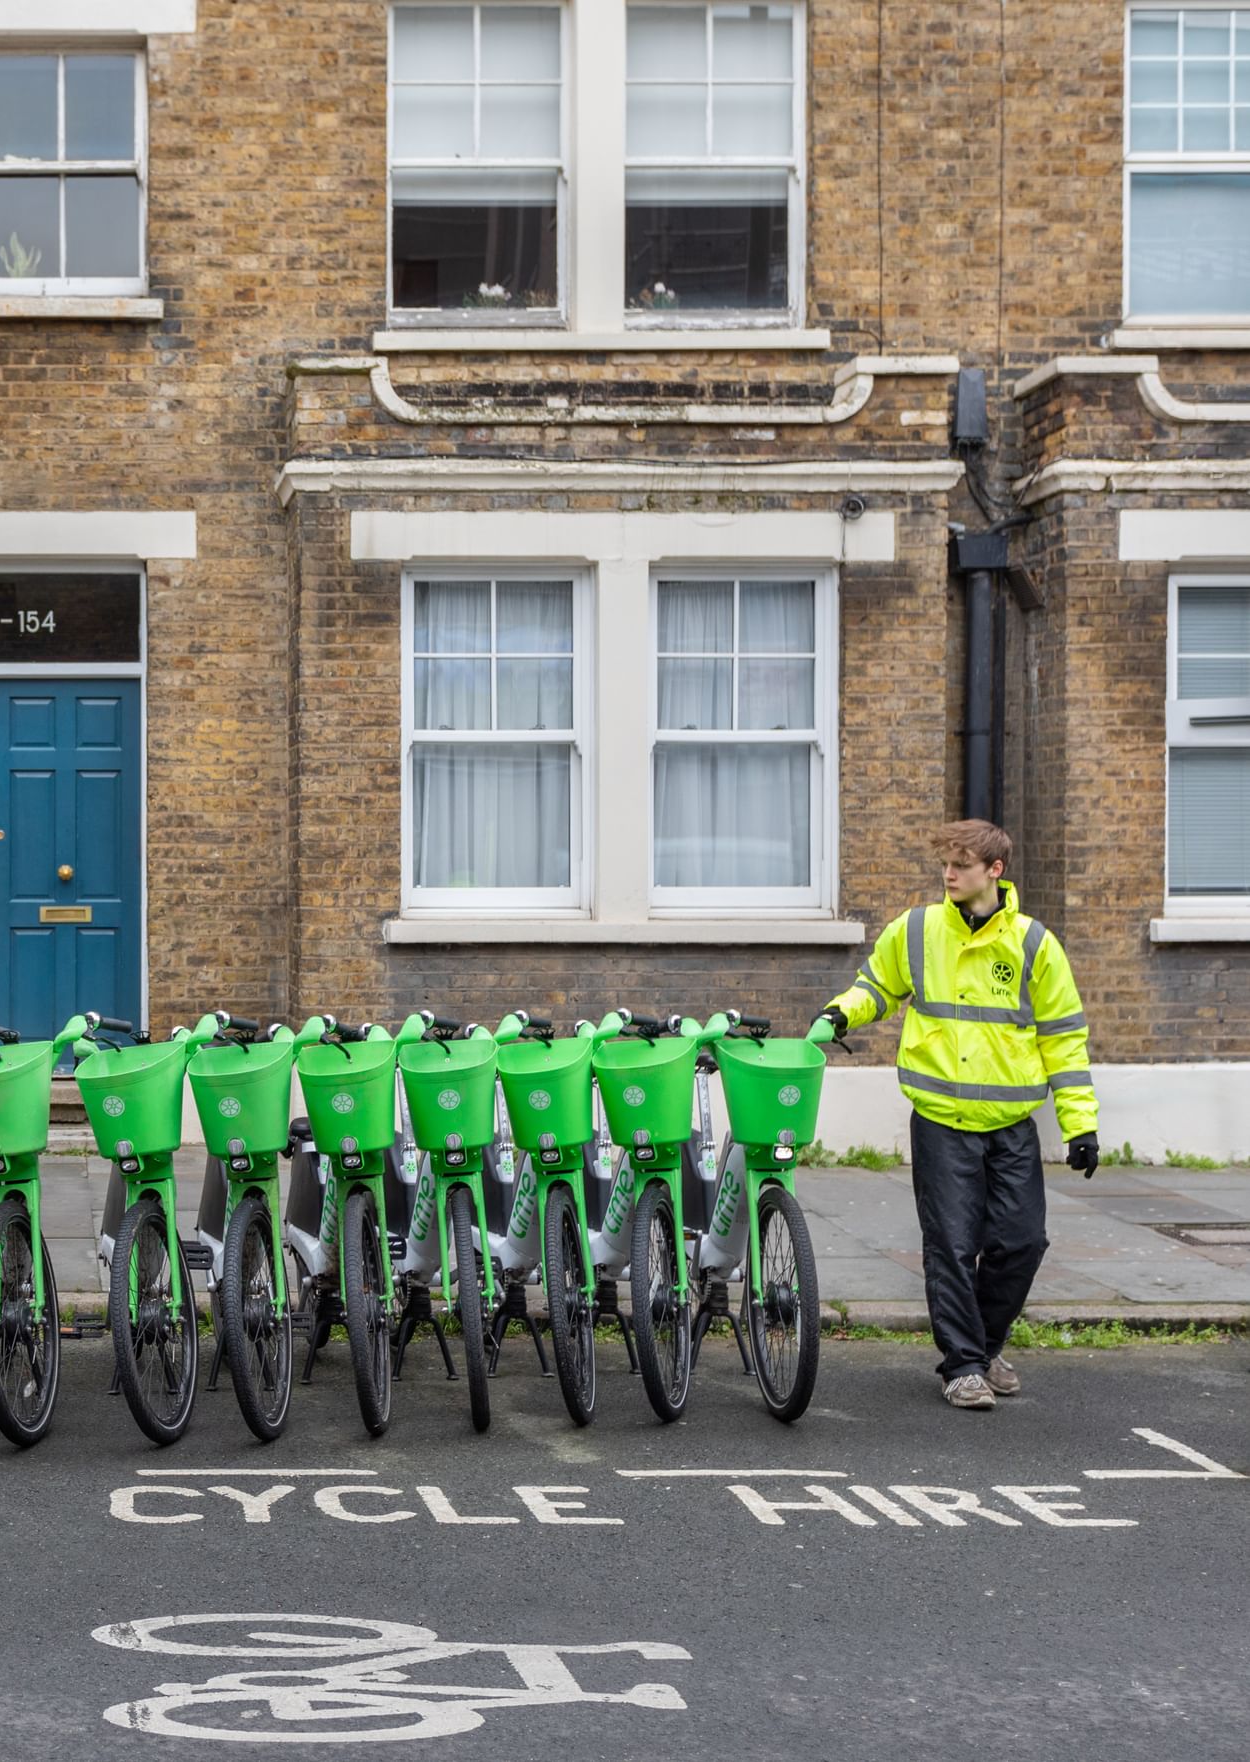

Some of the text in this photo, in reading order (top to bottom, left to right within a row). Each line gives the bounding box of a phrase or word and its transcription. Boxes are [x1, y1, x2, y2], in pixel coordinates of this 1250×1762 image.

[411, 1175, 436, 1241] Lime
[510, 1172, 537, 1239] Lime
[605, 1170, 634, 1234] Lime
[712, 1170, 740, 1237] Lime
[109, 1485, 625, 1525] CYCLE
[726, 1485, 1139, 1526] HIRE
